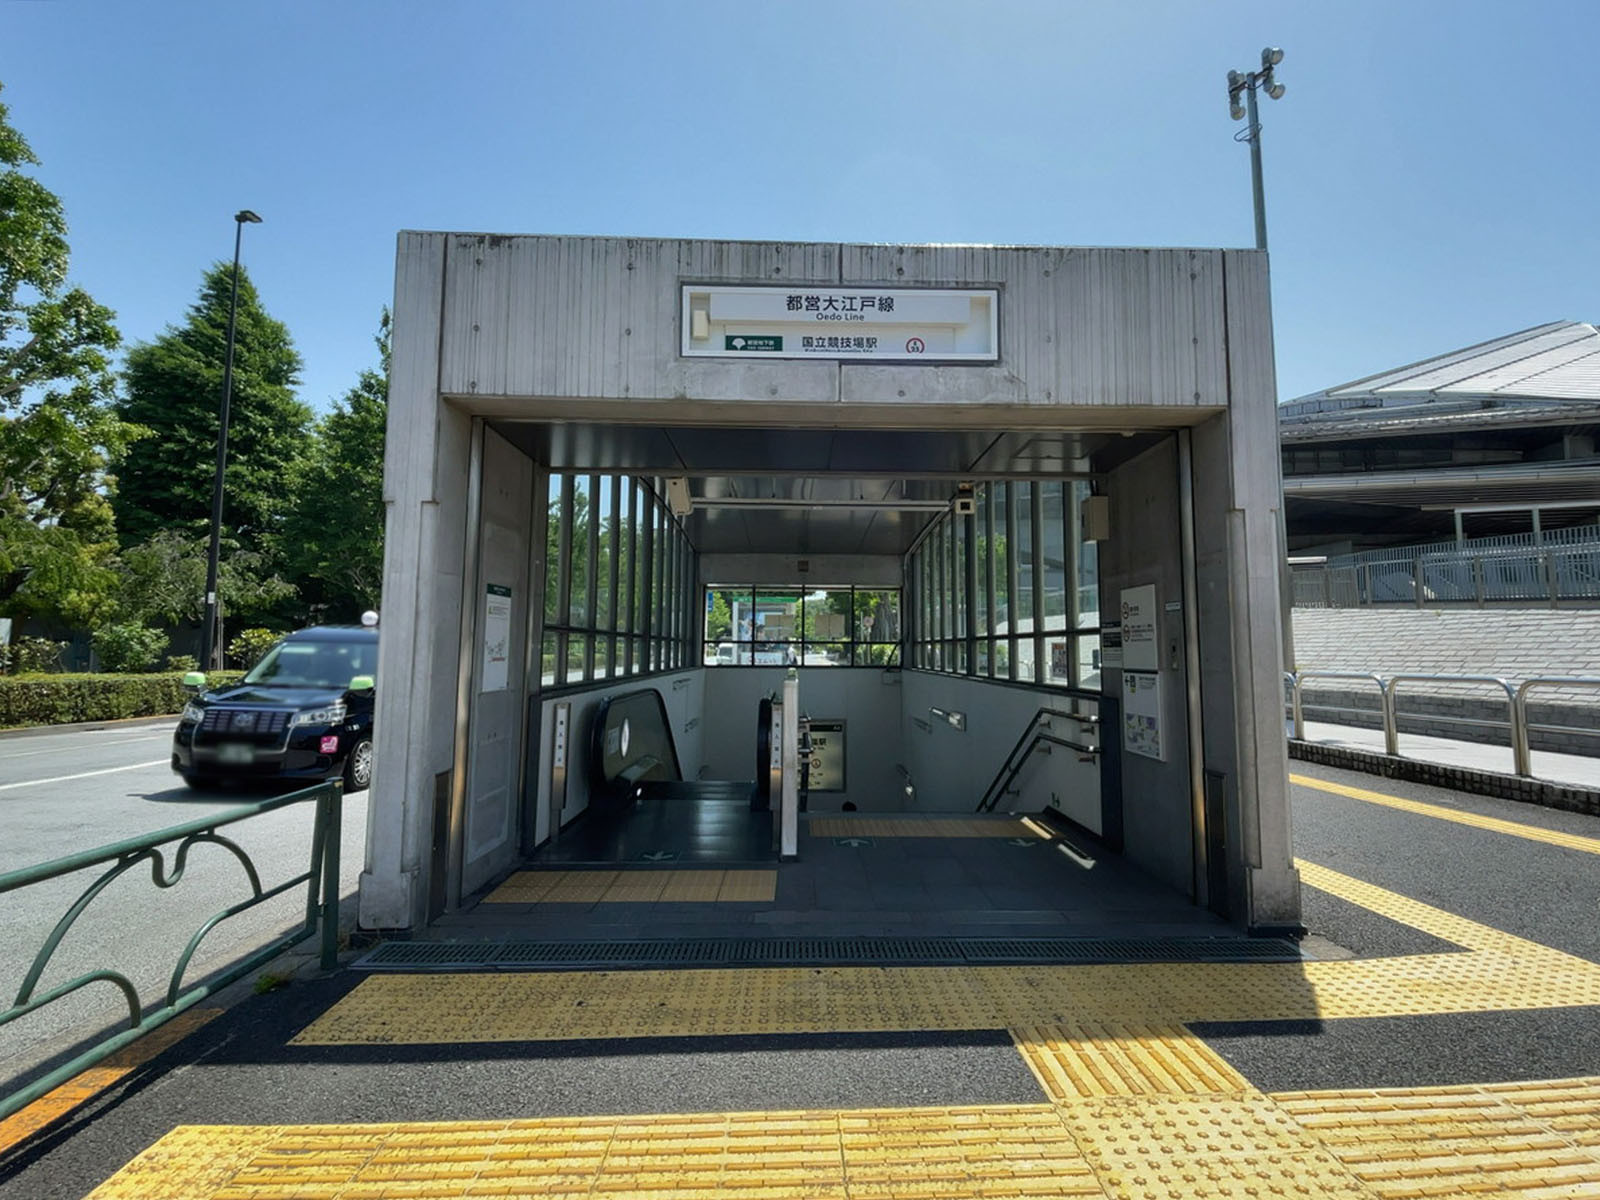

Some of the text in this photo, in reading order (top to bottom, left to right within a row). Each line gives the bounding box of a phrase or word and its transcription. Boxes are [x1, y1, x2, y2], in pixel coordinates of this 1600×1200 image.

[786, 295, 895, 312] 都営大江戸線
[816, 312, 865, 321] Oedo Line
[802, 336, 878, 348] 国立競技場駅
